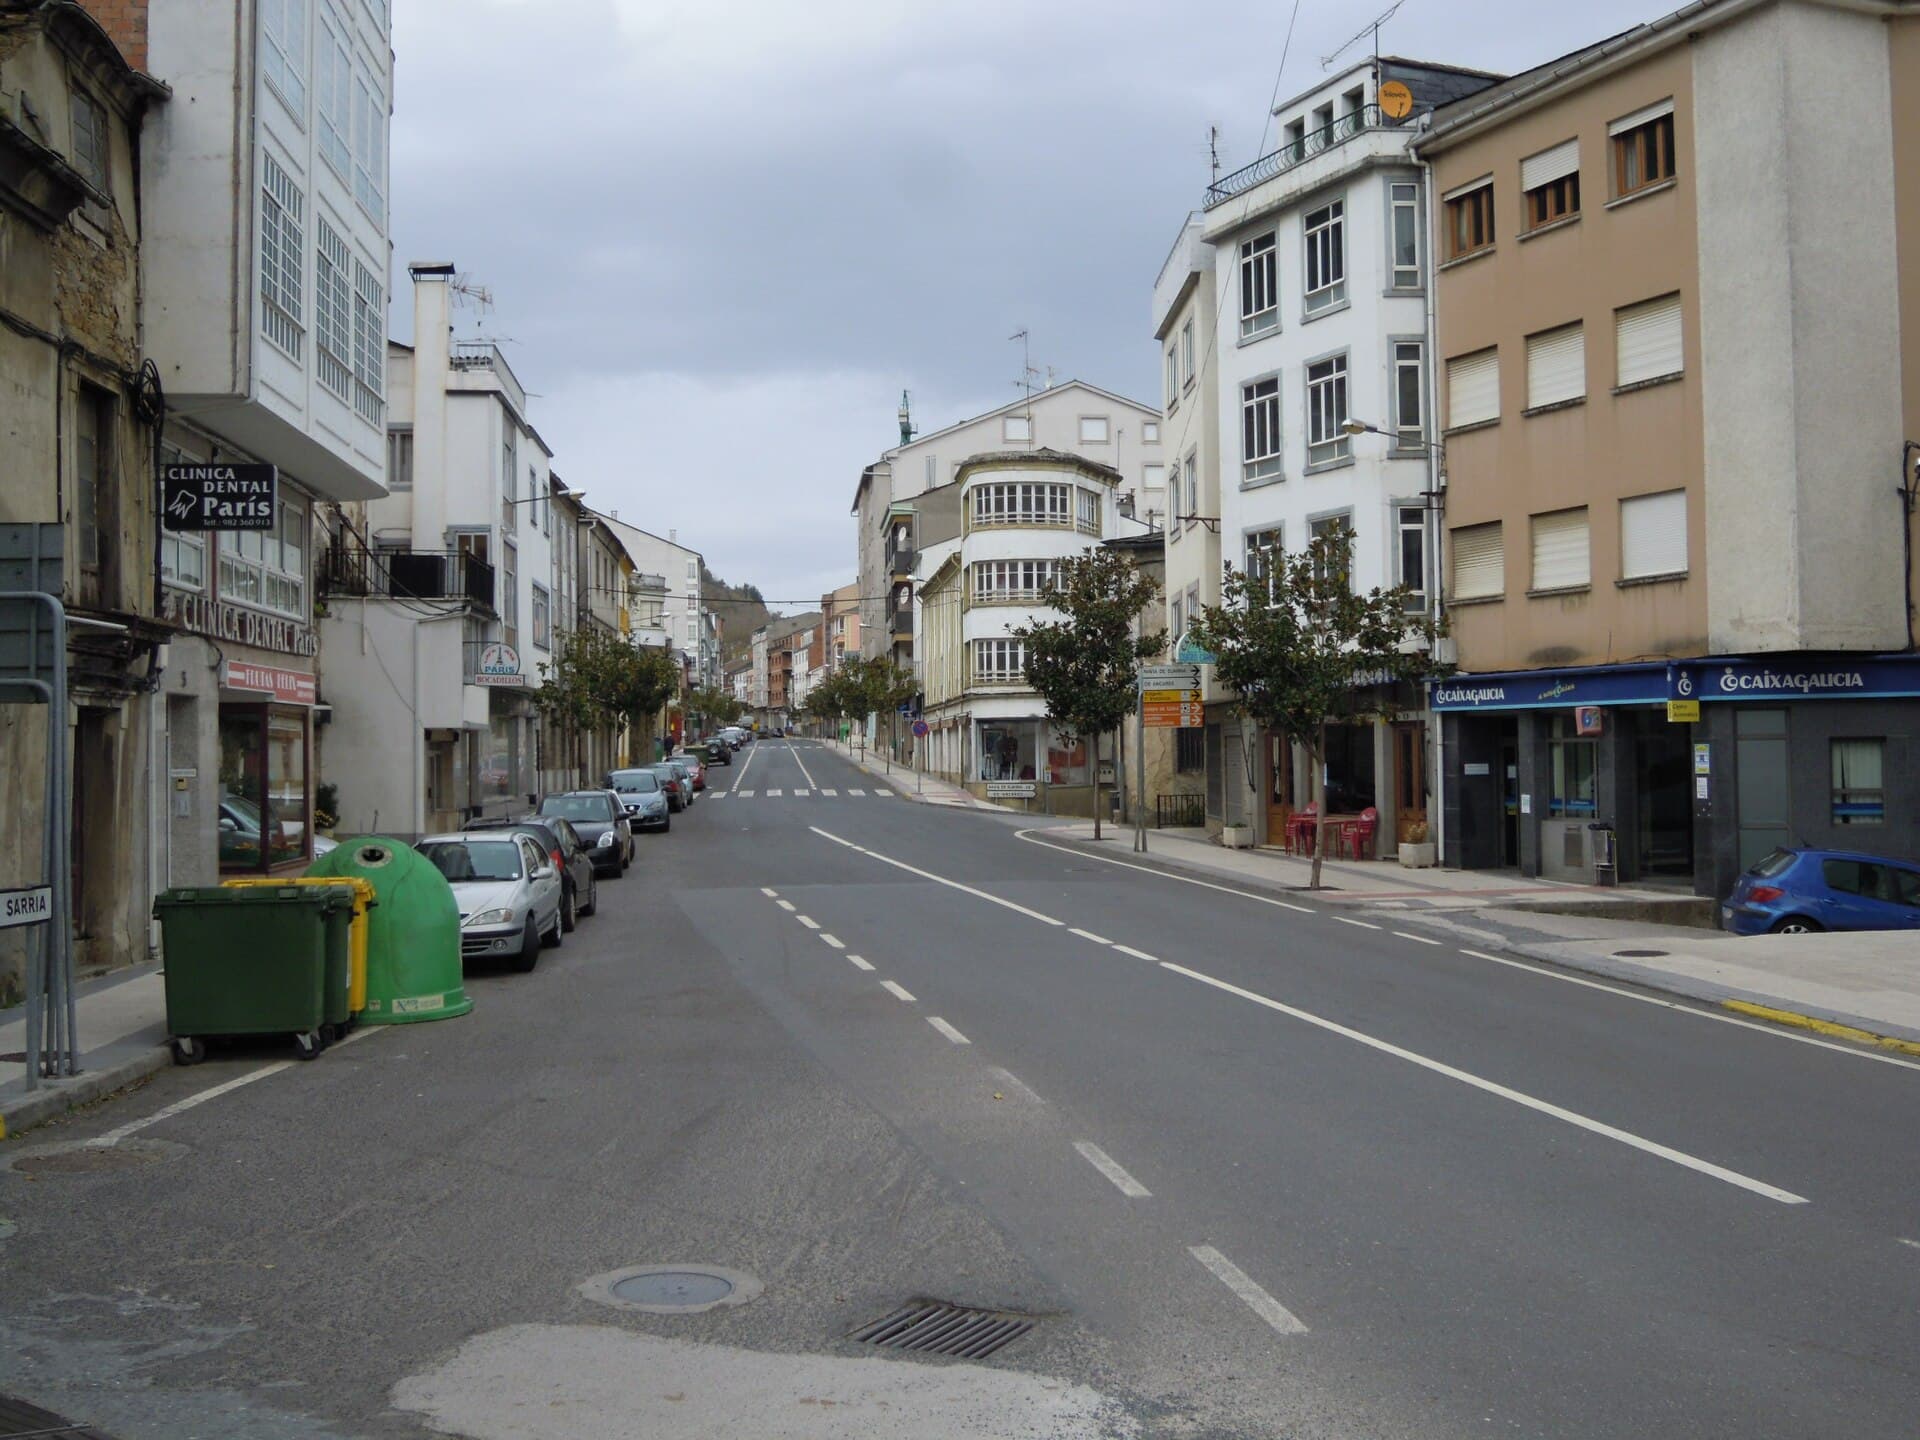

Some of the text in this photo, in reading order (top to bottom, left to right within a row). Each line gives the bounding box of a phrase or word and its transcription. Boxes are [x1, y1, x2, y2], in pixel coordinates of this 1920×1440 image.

[168, 467, 236, 480] CLINICA
[203, 481, 271, 493] DENTAL
[203, 496, 271, 516] París
[182, 593, 241, 641] CLINICA
[245, 612, 290, 653] DENTAL
[476, 676, 522, 685] BOCADILLOS
[1739, 670, 1864, 692] CAIXAGALICIA
[1445, 686, 1505, 705] CAIXAGALICIA
[6, 895, 47, 917] SARRIA
